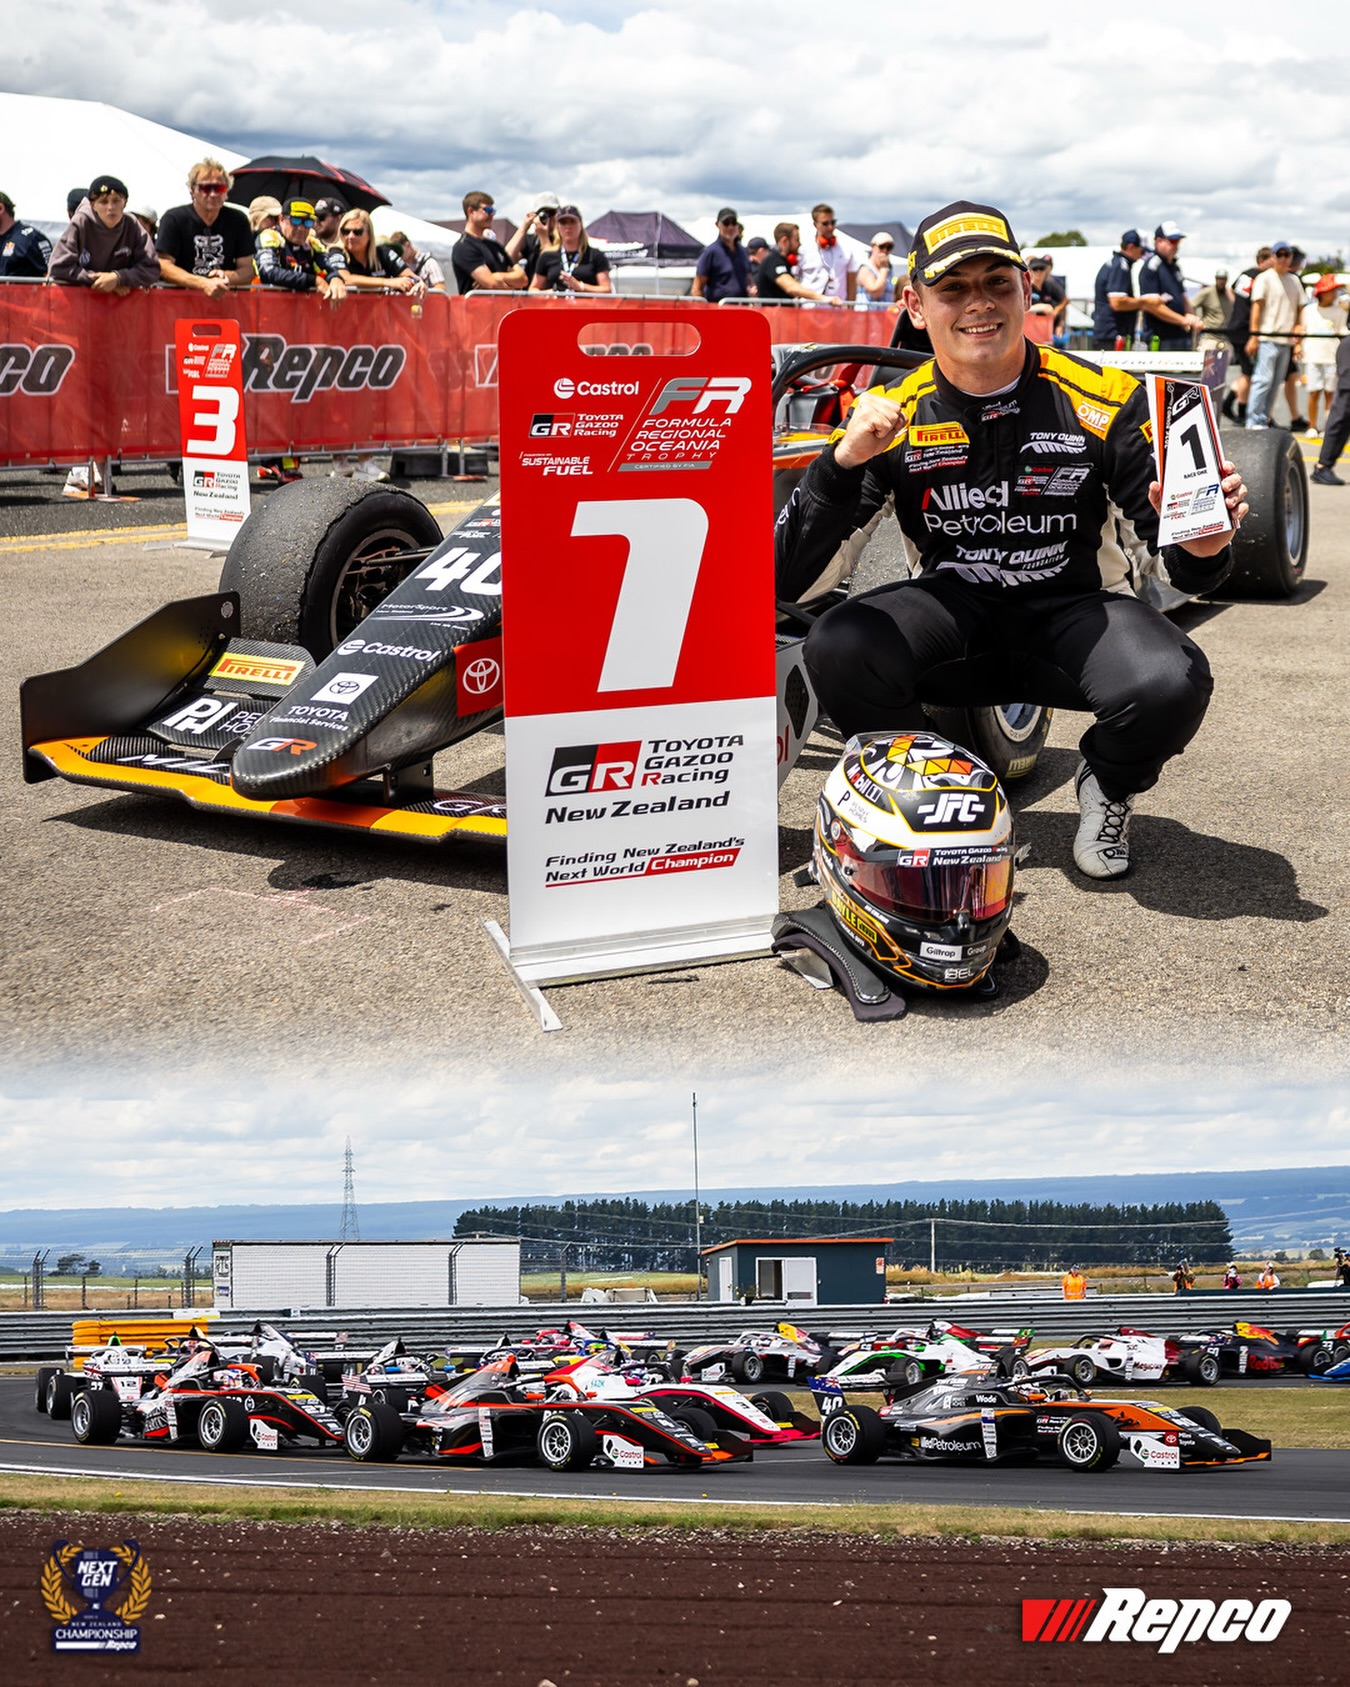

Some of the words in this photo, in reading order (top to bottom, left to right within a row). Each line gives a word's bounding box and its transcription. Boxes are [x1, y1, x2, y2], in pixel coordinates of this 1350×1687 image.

[241, 333, 407, 403] Repco
[577, 381, 639, 395] Castrol
[649, 377, 752, 415] FR
[187, 385, 240, 456] 3
[577, 413, 624, 421] TOYOTA
[642, 418, 732, 428] FORMULA
[1078, 404, 1110, 427] OMP
[530, 422, 571, 436] GR
[574, 429, 616, 437] Racing
[635, 429, 726, 439] REGIONAL
[917, 427, 965, 442] PIRELLI
[1030, 432, 1058, 440] TONY
[630, 439, 720, 451] OCEANIA
[1180, 424, 1207, 470] 1
[522, 456, 590, 466] SUSTAINABLE
[626, 452, 717, 460] TROPHY
[543, 465, 593, 476] FUEL
[921, 480, 1009, 511] Allied
[1196, 483, 1219, 498] FR
[923, 511, 1077, 536] Petroleum
[956, 544, 1008, 564] TONY
[1009, 540, 1069, 565] QUINN
[570, 498, 709, 692] 1
[363, 642, 442, 662] Castrol
[216, 658, 297, 681] PIRELLI
[288, 705, 350, 722] TOYOTA
[269, 715, 310, 726] Financial
[310, 718, 349, 731] Services
[246, 737, 318, 755] GR
[647, 735, 744, 754] TOYOTA
[644, 752, 734, 770] GAZOO
[550, 760, 635, 794] GR
[641, 768, 730, 787] Racing
[846, 763, 872, 794] Mobil
[545, 806, 606, 824] New
[610, 791, 731, 818] Zealand
[545, 851, 617, 868] Finding
[623, 847, 660, 859] New
[665, 837, 745, 854] Zealand's
[899, 857, 928, 866] GR
[933, 857, 960, 866] New
[961, 855, 1002, 865] Zealand
[545, 869, 588, 882] Next
[592, 861, 646, 877] World
[651, 852, 734, 871] Champion
[822, 1396, 843, 1414] 40
[619, 1450, 643, 1459] Castrol
[1150, 1450, 1178, 1459] Castrol
